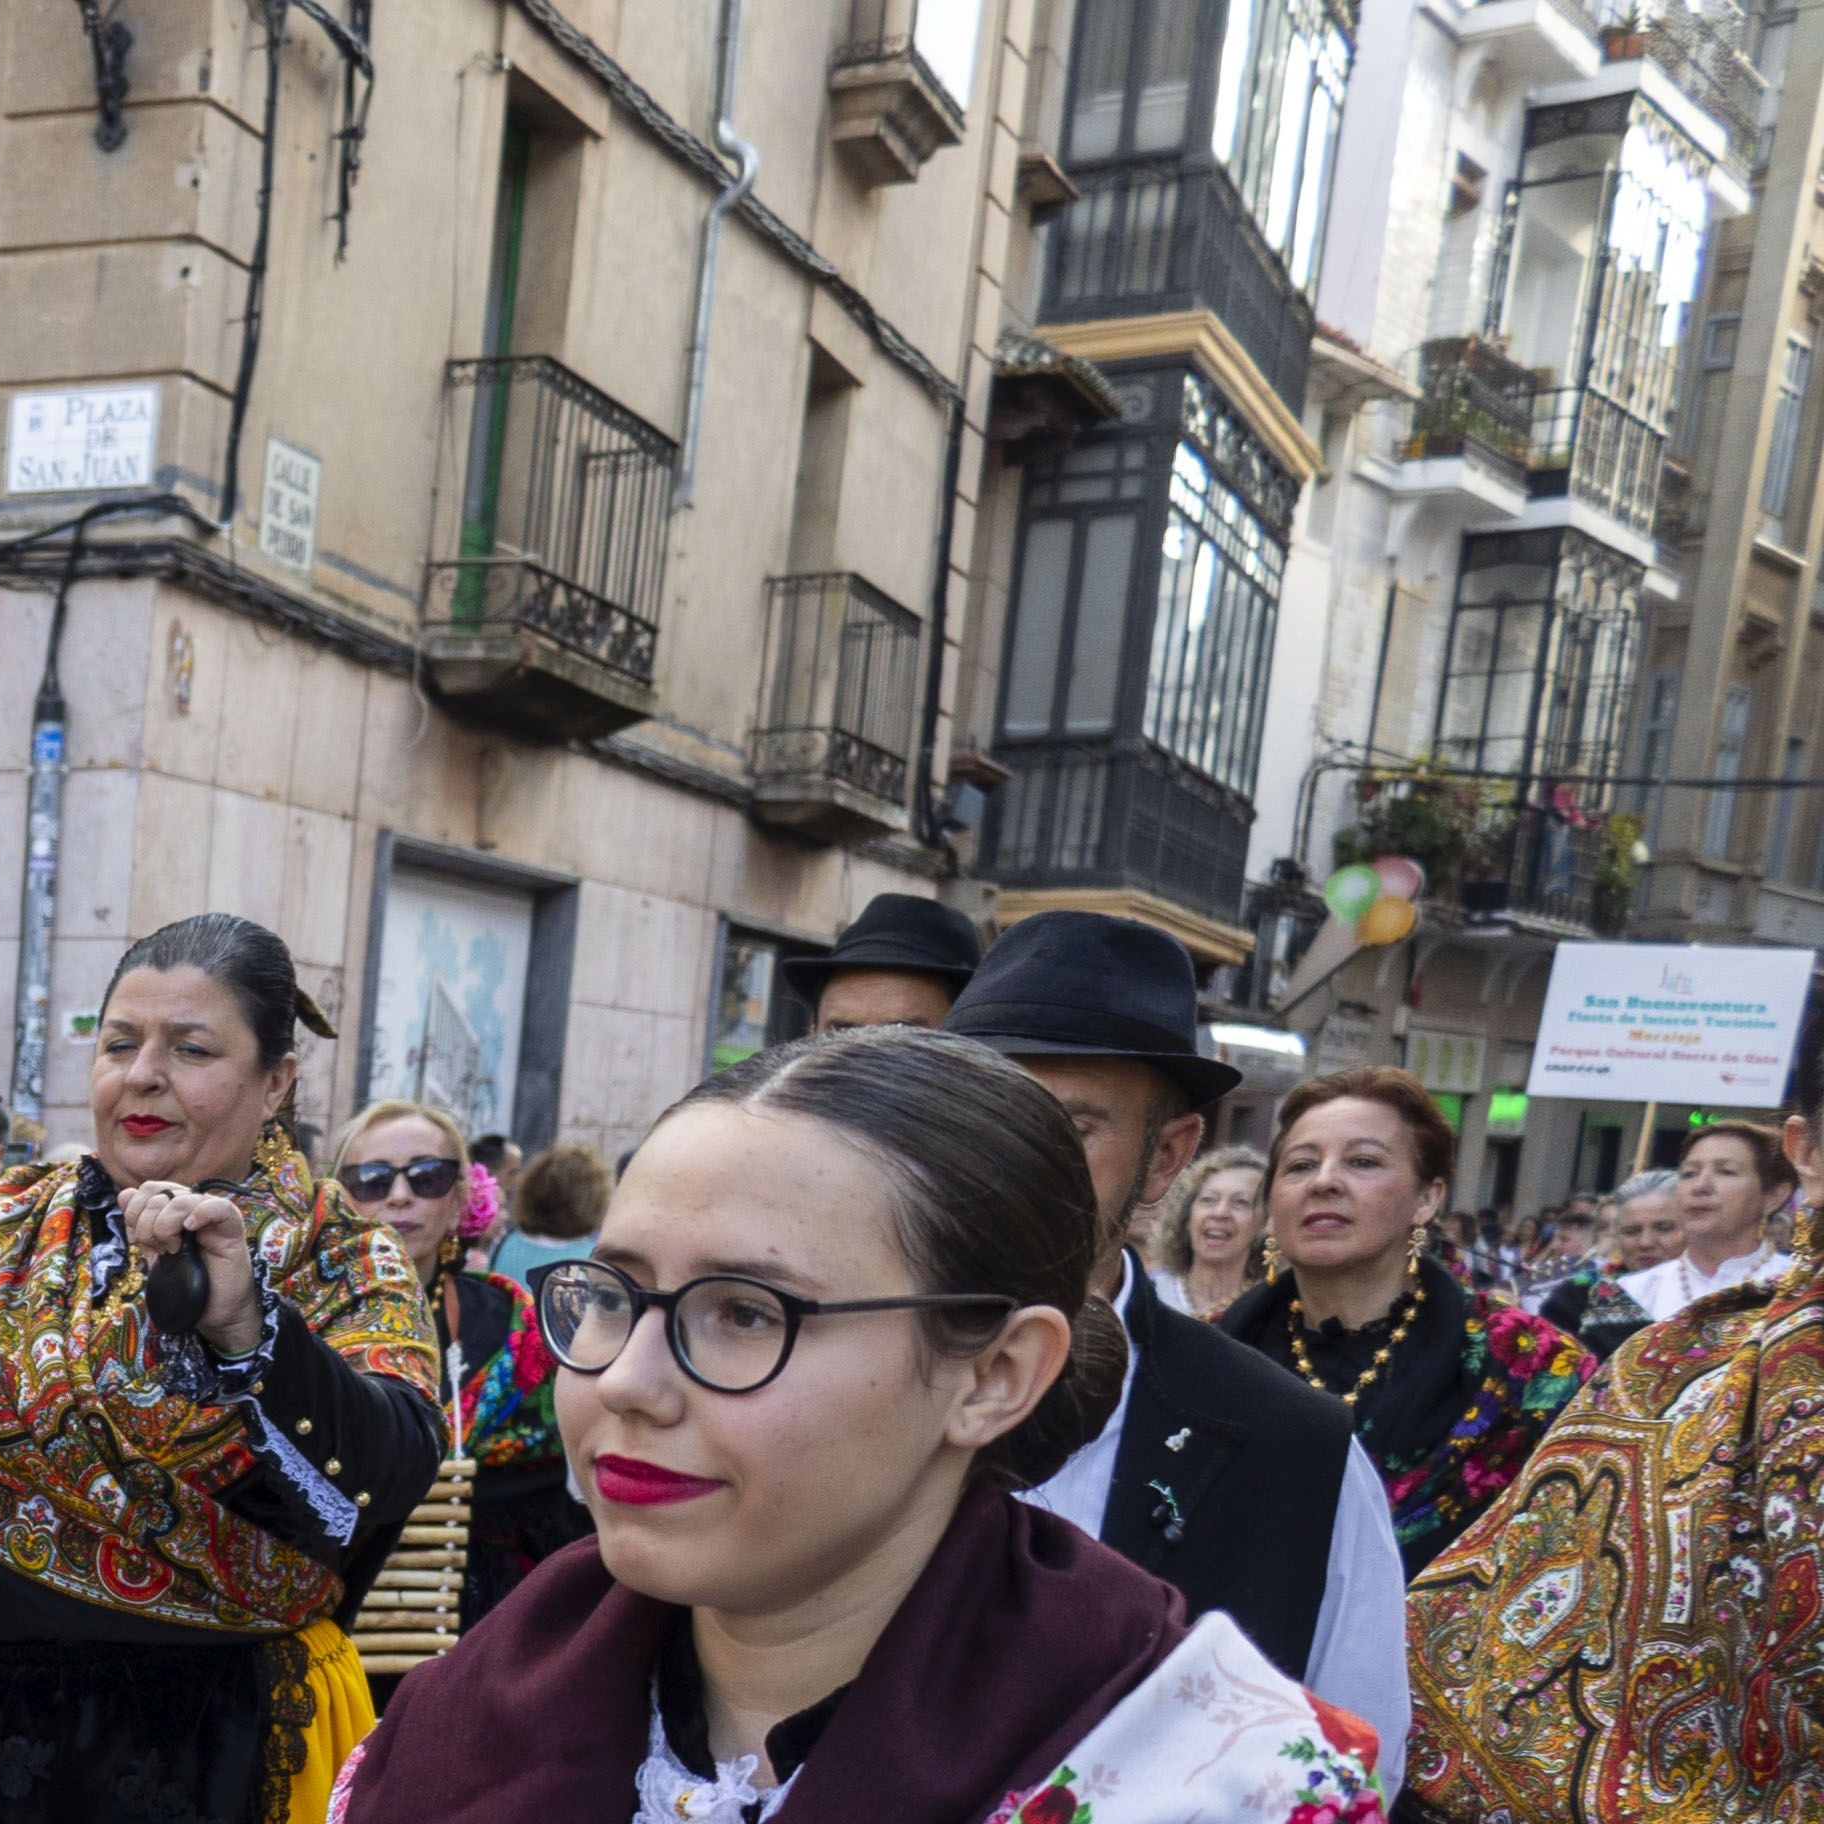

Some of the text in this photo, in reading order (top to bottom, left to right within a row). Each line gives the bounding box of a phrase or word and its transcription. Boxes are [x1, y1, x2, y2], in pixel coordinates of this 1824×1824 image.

[64, 397, 149, 426] PLAZA
[86, 427, 118, 447] DE
[17, 452, 140, 487] SAN JUAN
[272, 452, 312, 496] CALLE
[1583, 994, 1767, 1013] San Buenaventura
[1567, 1011, 1614, 1024] Fiesta
[1618, 1013, 1636, 1025] de
[1550, 1045, 1601, 1059] Parque
[1605, 1047, 1667, 1060] Cultural
[1670, 1049, 1717, 1062] Sierra
[1721, 1051, 1739, 1063] de
